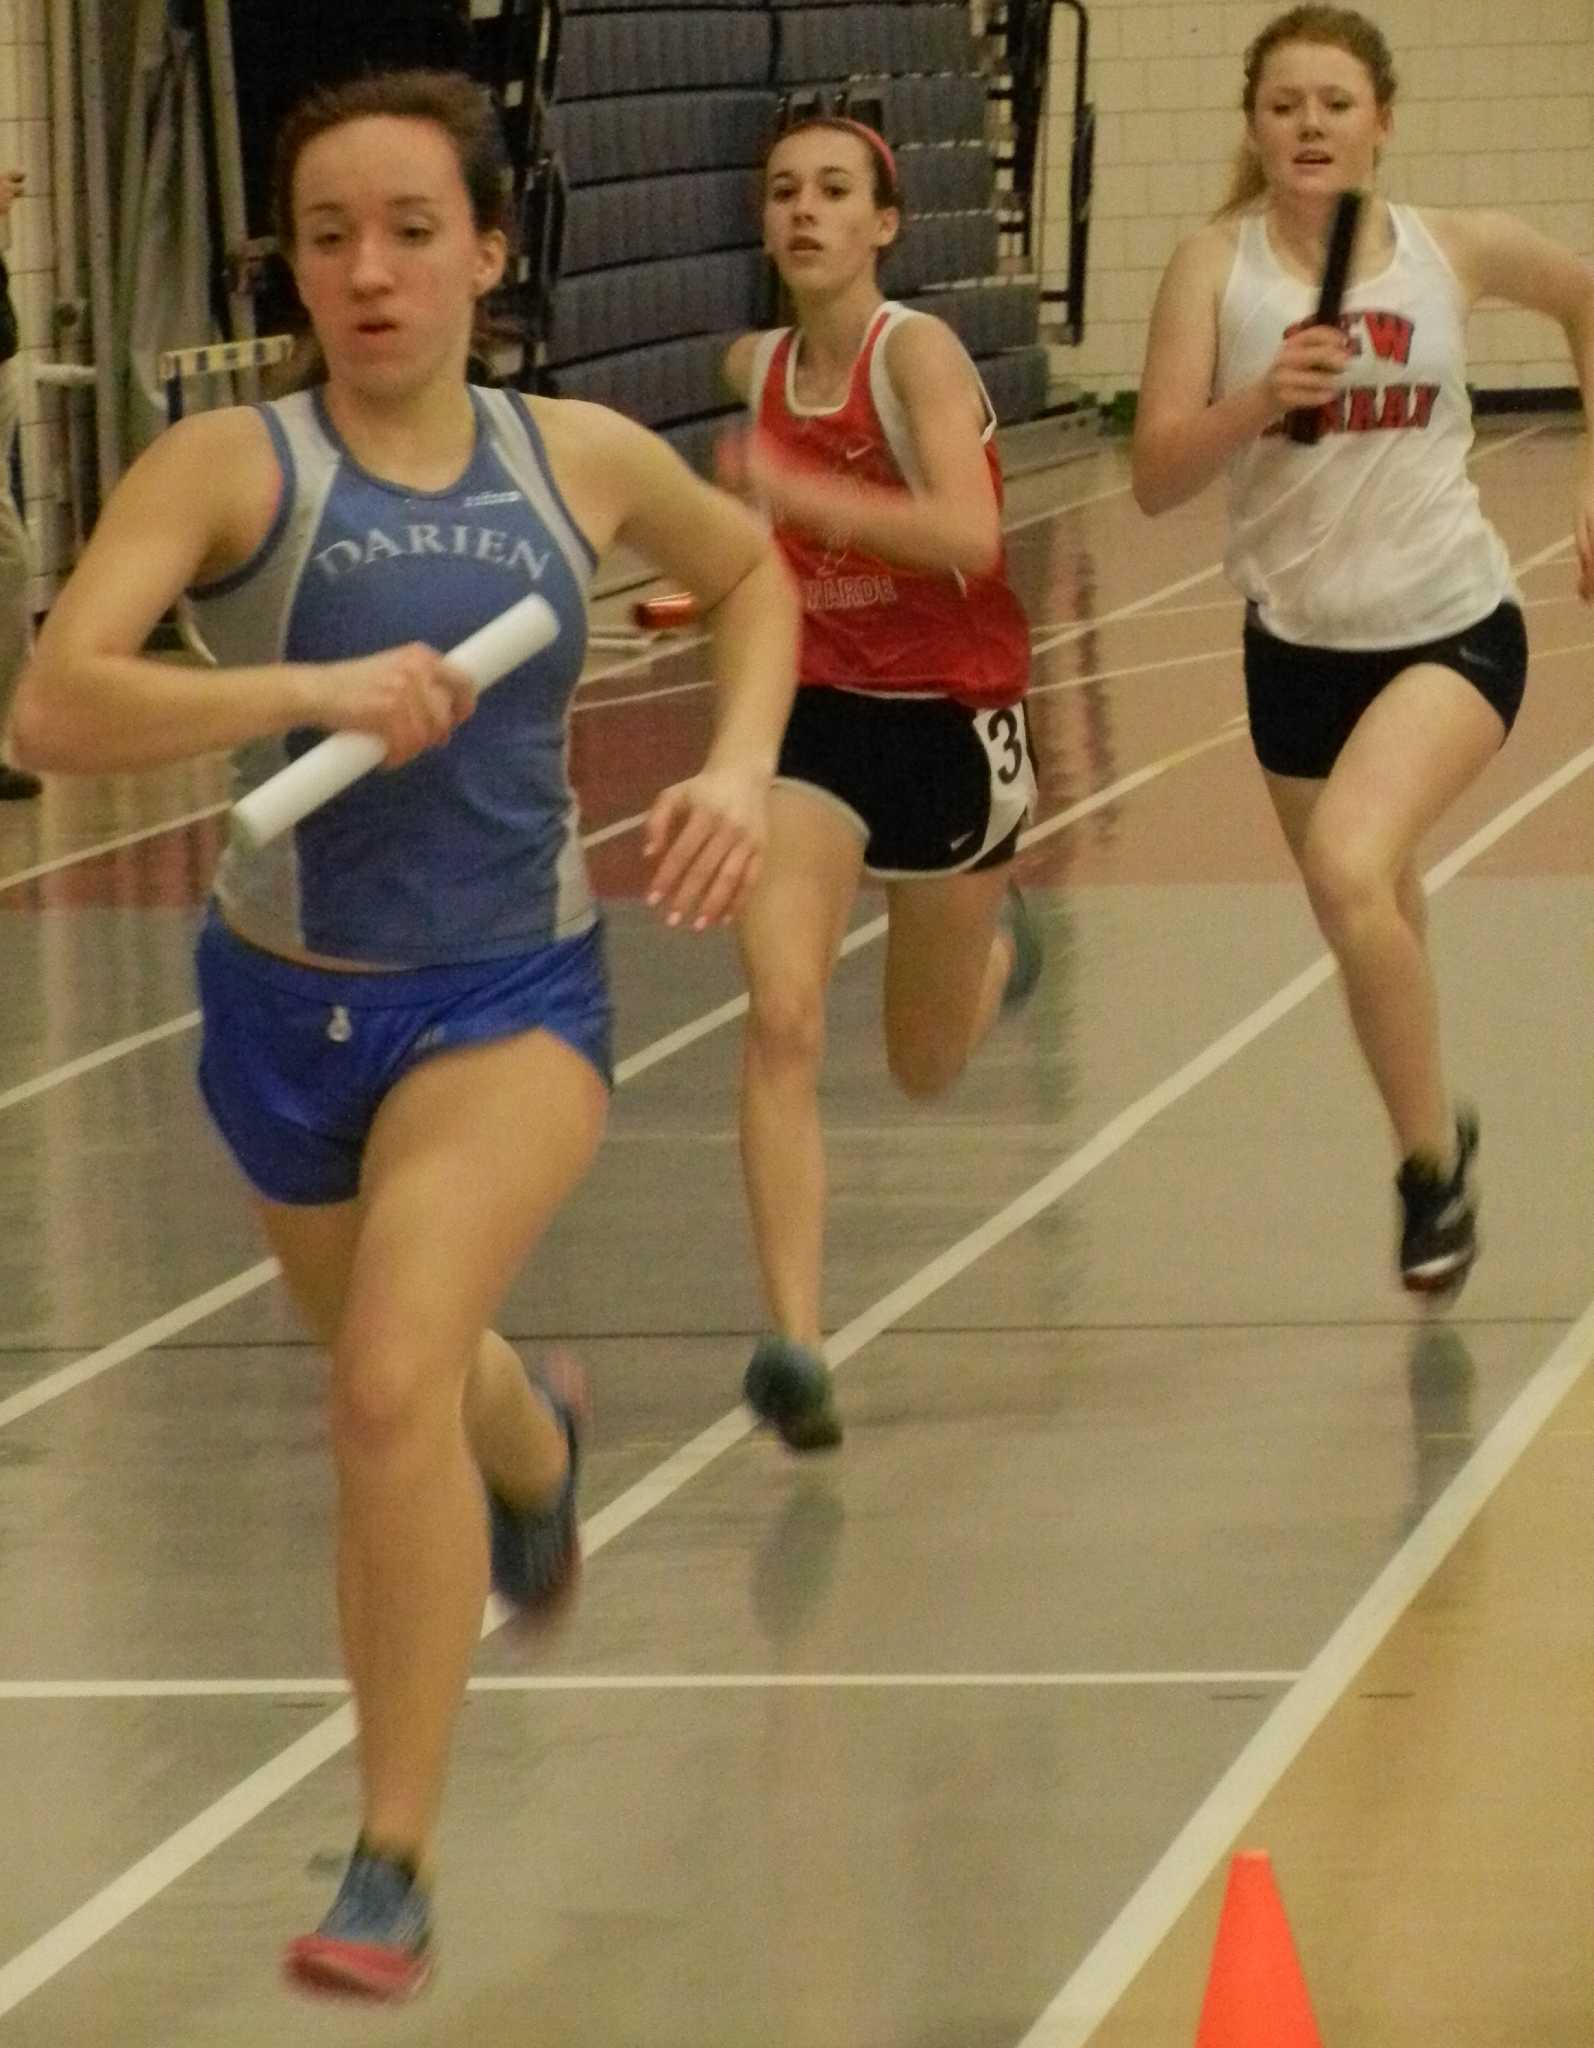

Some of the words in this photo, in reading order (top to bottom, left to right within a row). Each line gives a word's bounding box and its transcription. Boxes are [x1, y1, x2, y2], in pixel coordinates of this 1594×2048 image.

[1283, 310, 1416, 366] EW
[1261, 383, 1441, 439] NAAN
[314, 523, 550, 582] DARIEN
[987, 709, 1022, 785] 3
